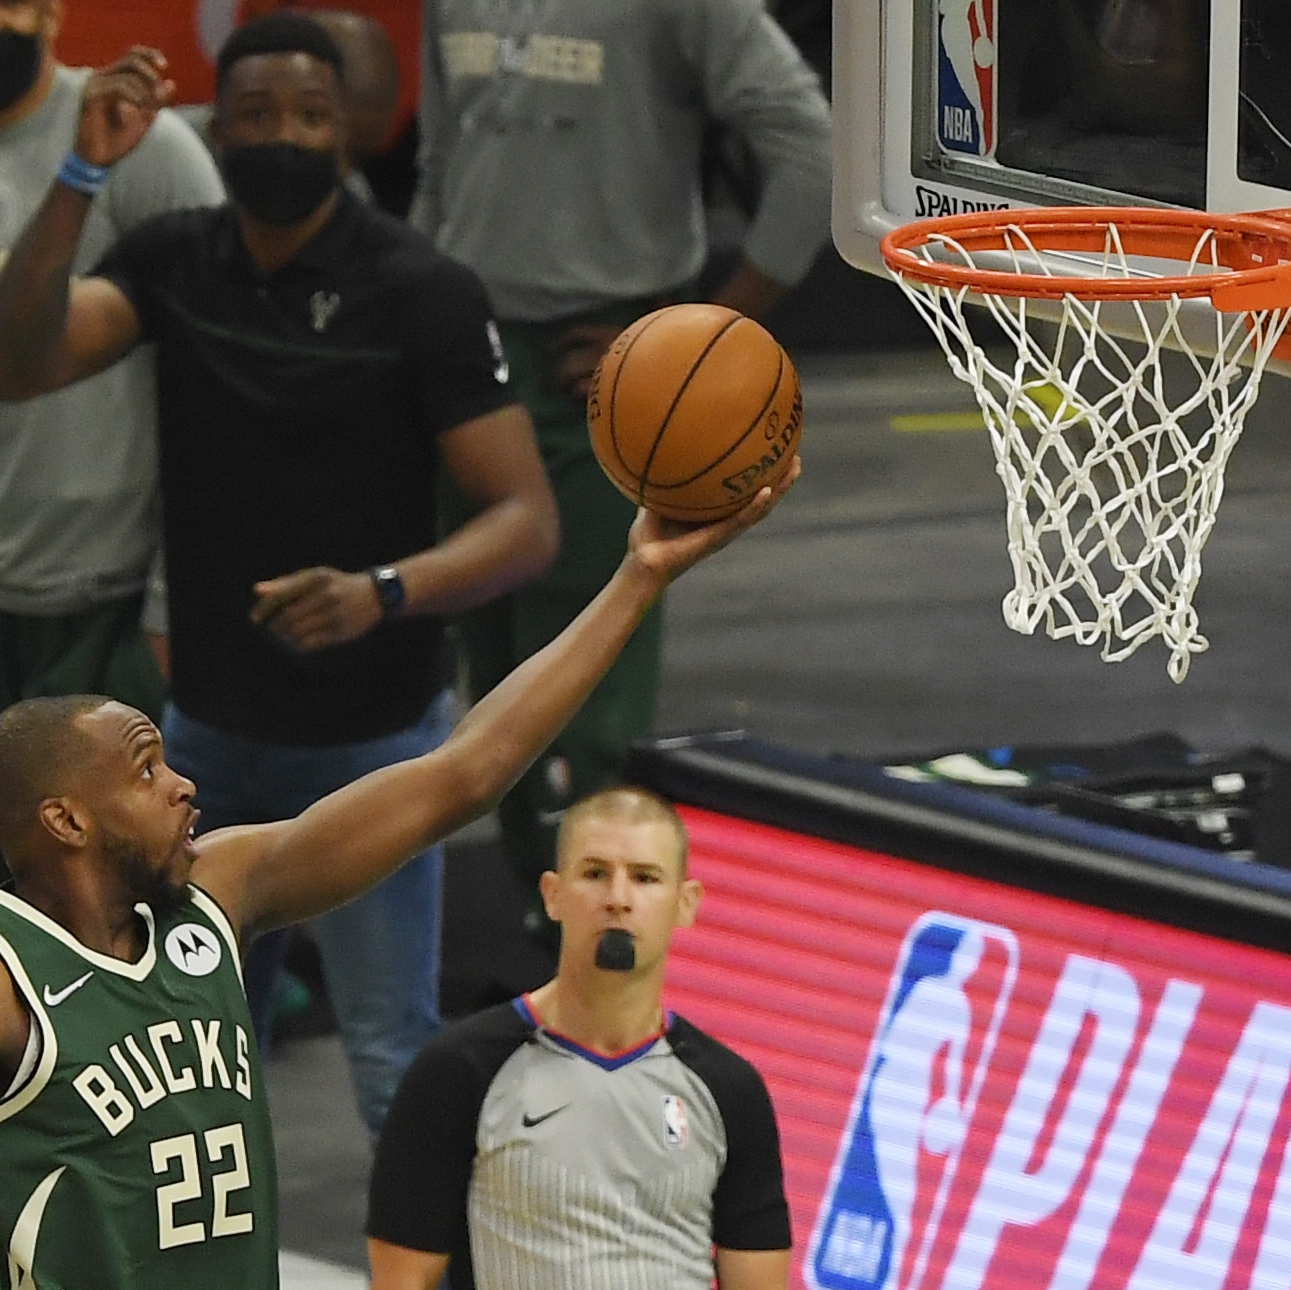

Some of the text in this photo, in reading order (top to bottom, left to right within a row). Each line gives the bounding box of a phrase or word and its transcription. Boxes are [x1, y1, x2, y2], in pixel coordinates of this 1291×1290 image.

[943, 105, 973, 143] NBA
[915, 185, 1009, 217] SPALD
[721, 383, 803, 499] SPALDIN
[71, 1019, 252, 1137] BUCKS
[149, 1122, 254, 1250] 22
